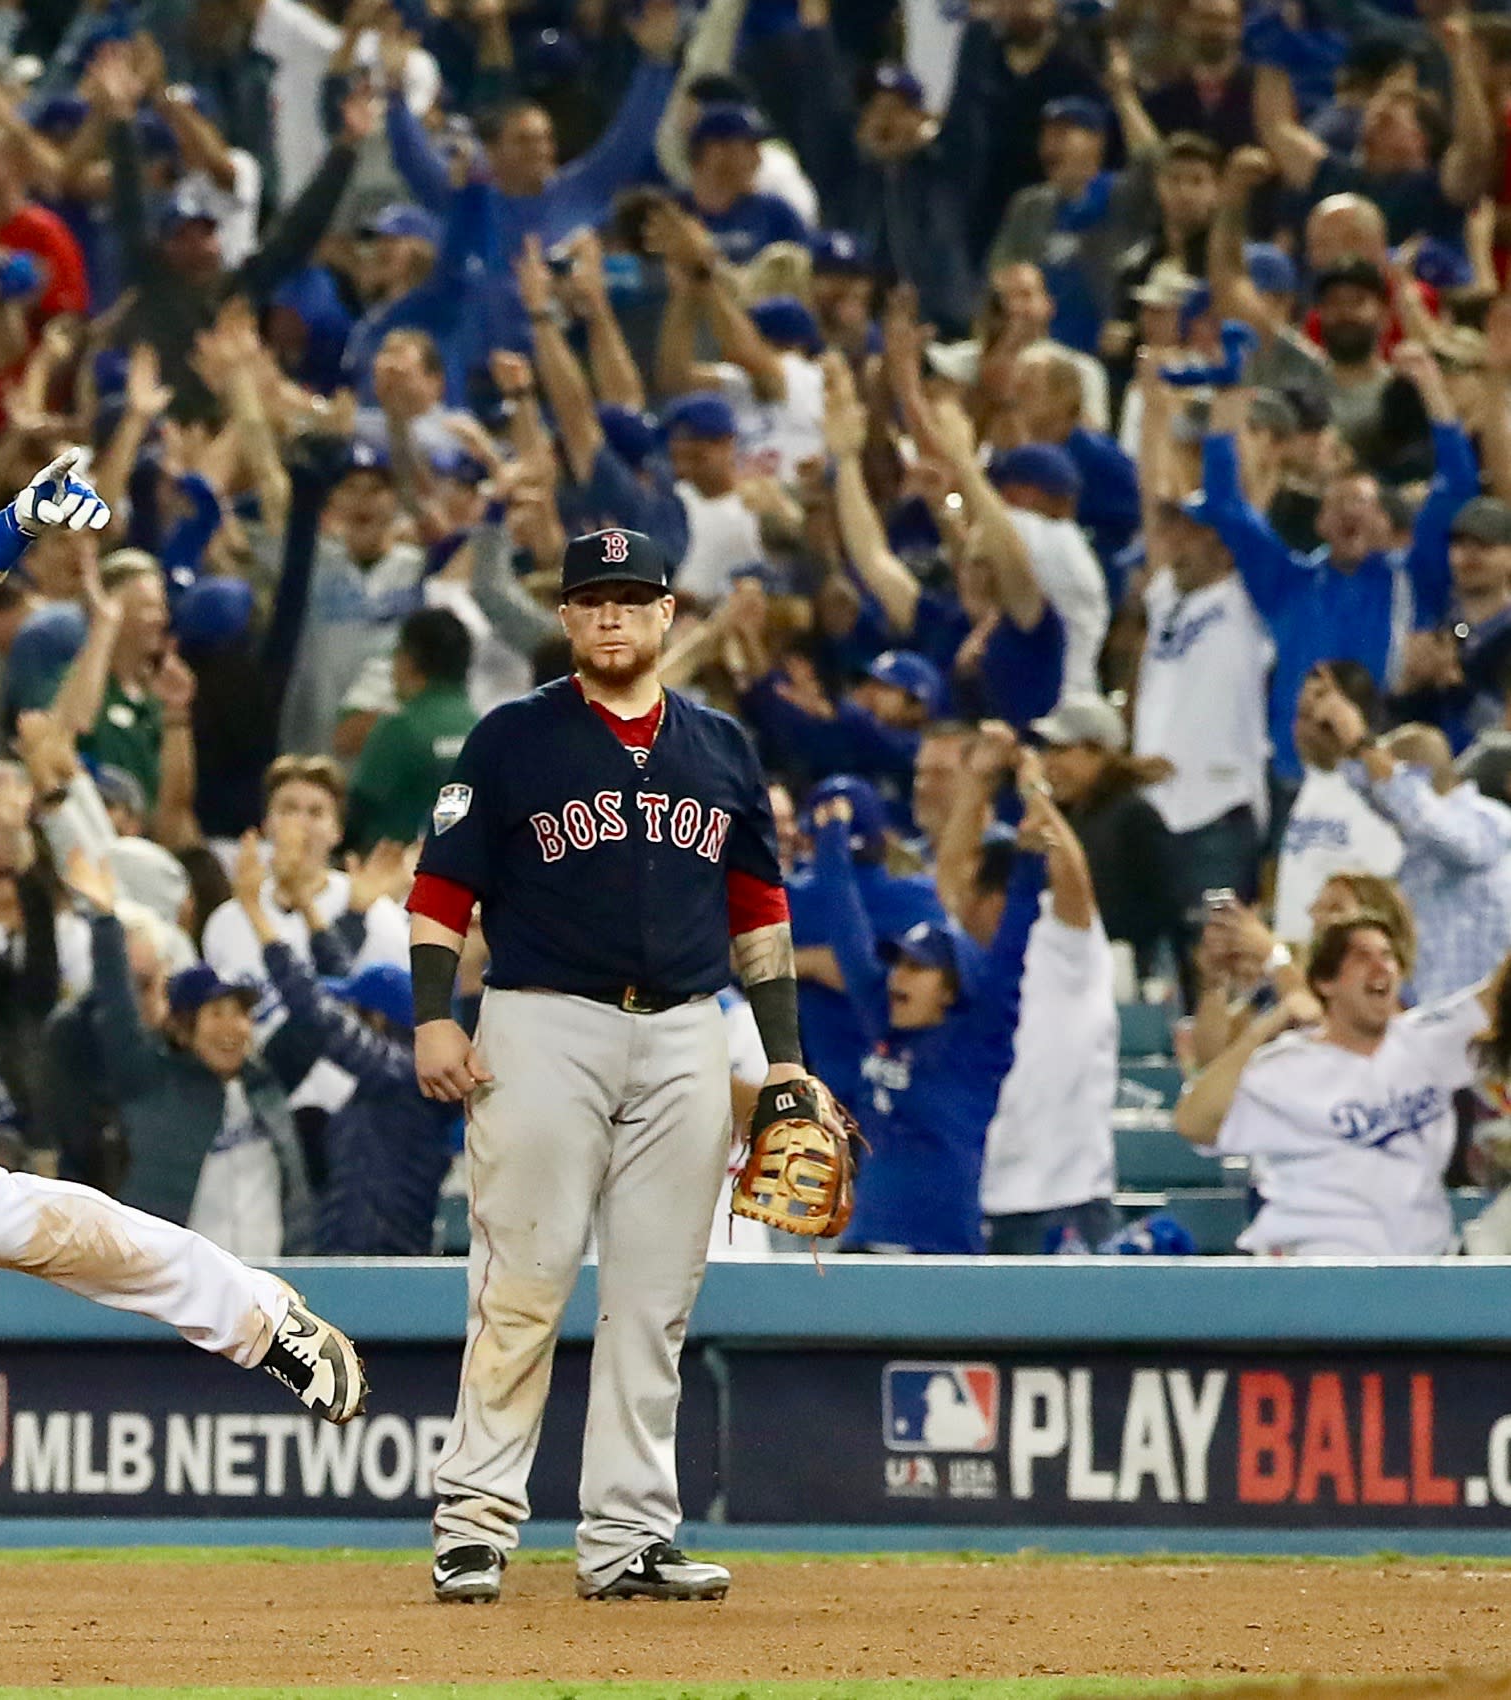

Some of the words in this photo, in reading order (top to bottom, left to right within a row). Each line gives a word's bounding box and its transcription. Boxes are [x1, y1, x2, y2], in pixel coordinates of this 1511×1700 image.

[601, 533, 629, 563] B
[530, 791, 731, 862] BOSTON
[11, 1409, 154, 1496] MLB
[165, 1411, 454, 1498] NETWOR
